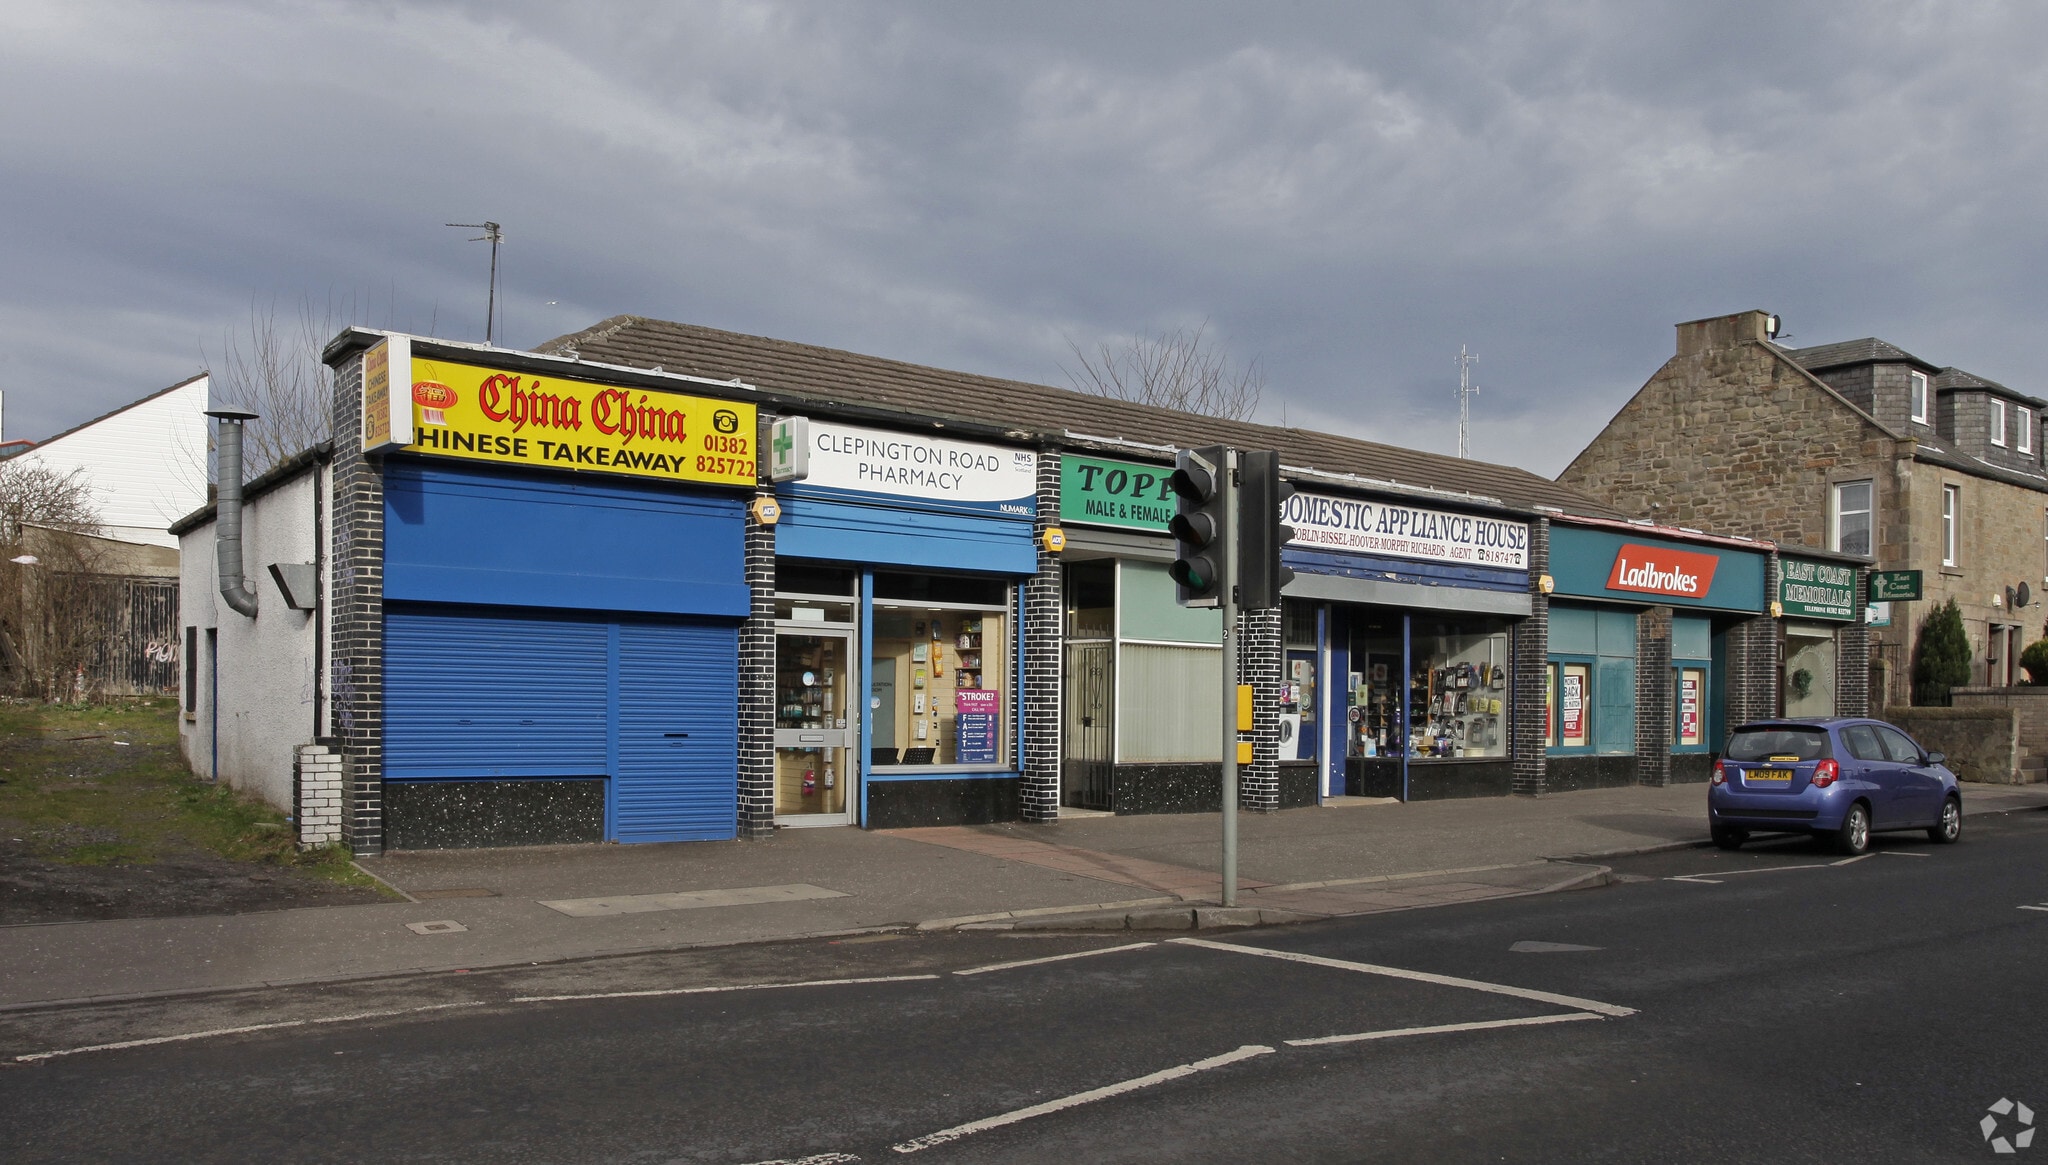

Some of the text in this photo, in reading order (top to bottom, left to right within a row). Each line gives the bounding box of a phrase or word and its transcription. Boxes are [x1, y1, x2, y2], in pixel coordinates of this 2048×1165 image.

[479, 373, 686, 445] China China
[410, 427, 686, 473] HINESE TAKEAWAY
[704, 433, 748, 456] 01382
[817, 433, 1000, 472] CLEPINGTON ROAD
[696, 455, 755, 478] 825722
[1014, 452, 1032, 463] NHS
[859, 462, 963, 490] PHARMACY
[1000, 503, 1028, 515] NUMARK
[1085, 499, 1171, 523] MALE & FEMALE
[1376, 507, 1471, 544] APPLIANCE
[1475, 520, 1527, 550] HOUSE
[1410, 541, 1446, 557] RICHARDS
[1449, 546, 1472, 560] AGENT
[1619, 558, 1698, 593] Ladbrokes
[1786, 561, 1851, 586] EAST COAST
[1893, 573, 1910, 581] East
[1785, 584, 1852, 607] MEMORIALS
[1890, 582, 1910, 590] Coast
[1223, 629, 1228, 639] 2
[961, 692, 995, 701] STROKE?
[1564, 686, 1579, 698] BACK
[1771, 770, 1788, 779] FAK
